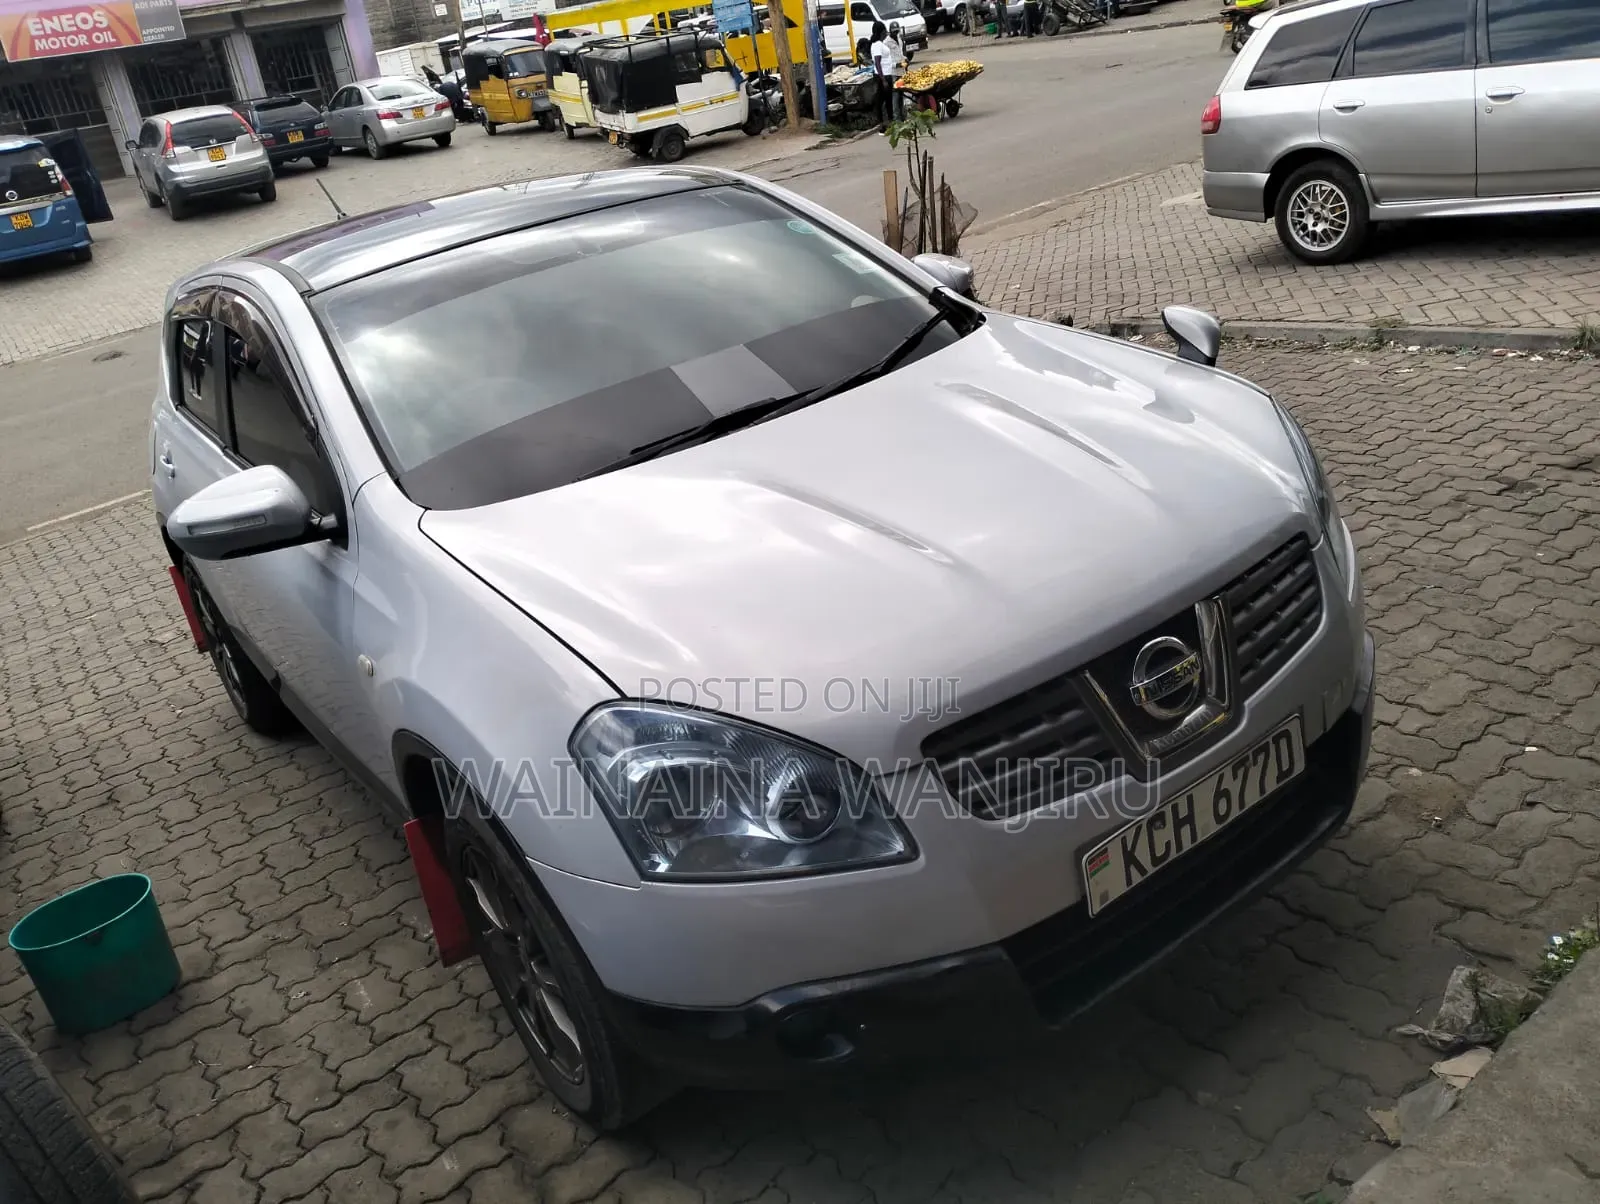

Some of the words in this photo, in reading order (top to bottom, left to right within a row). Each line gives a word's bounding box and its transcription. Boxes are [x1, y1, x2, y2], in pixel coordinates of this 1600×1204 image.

[27, 11, 109, 36] ENEOS
[142, 25, 175, 35] APPOINTED
[34, 36, 88, 51] MOTOR
[93, 31, 116, 44] OIL
[143, 33, 165, 42] DEALER
[1120, 793, 1198, 888] KCH
[1212, 728, 1295, 825] 677D
